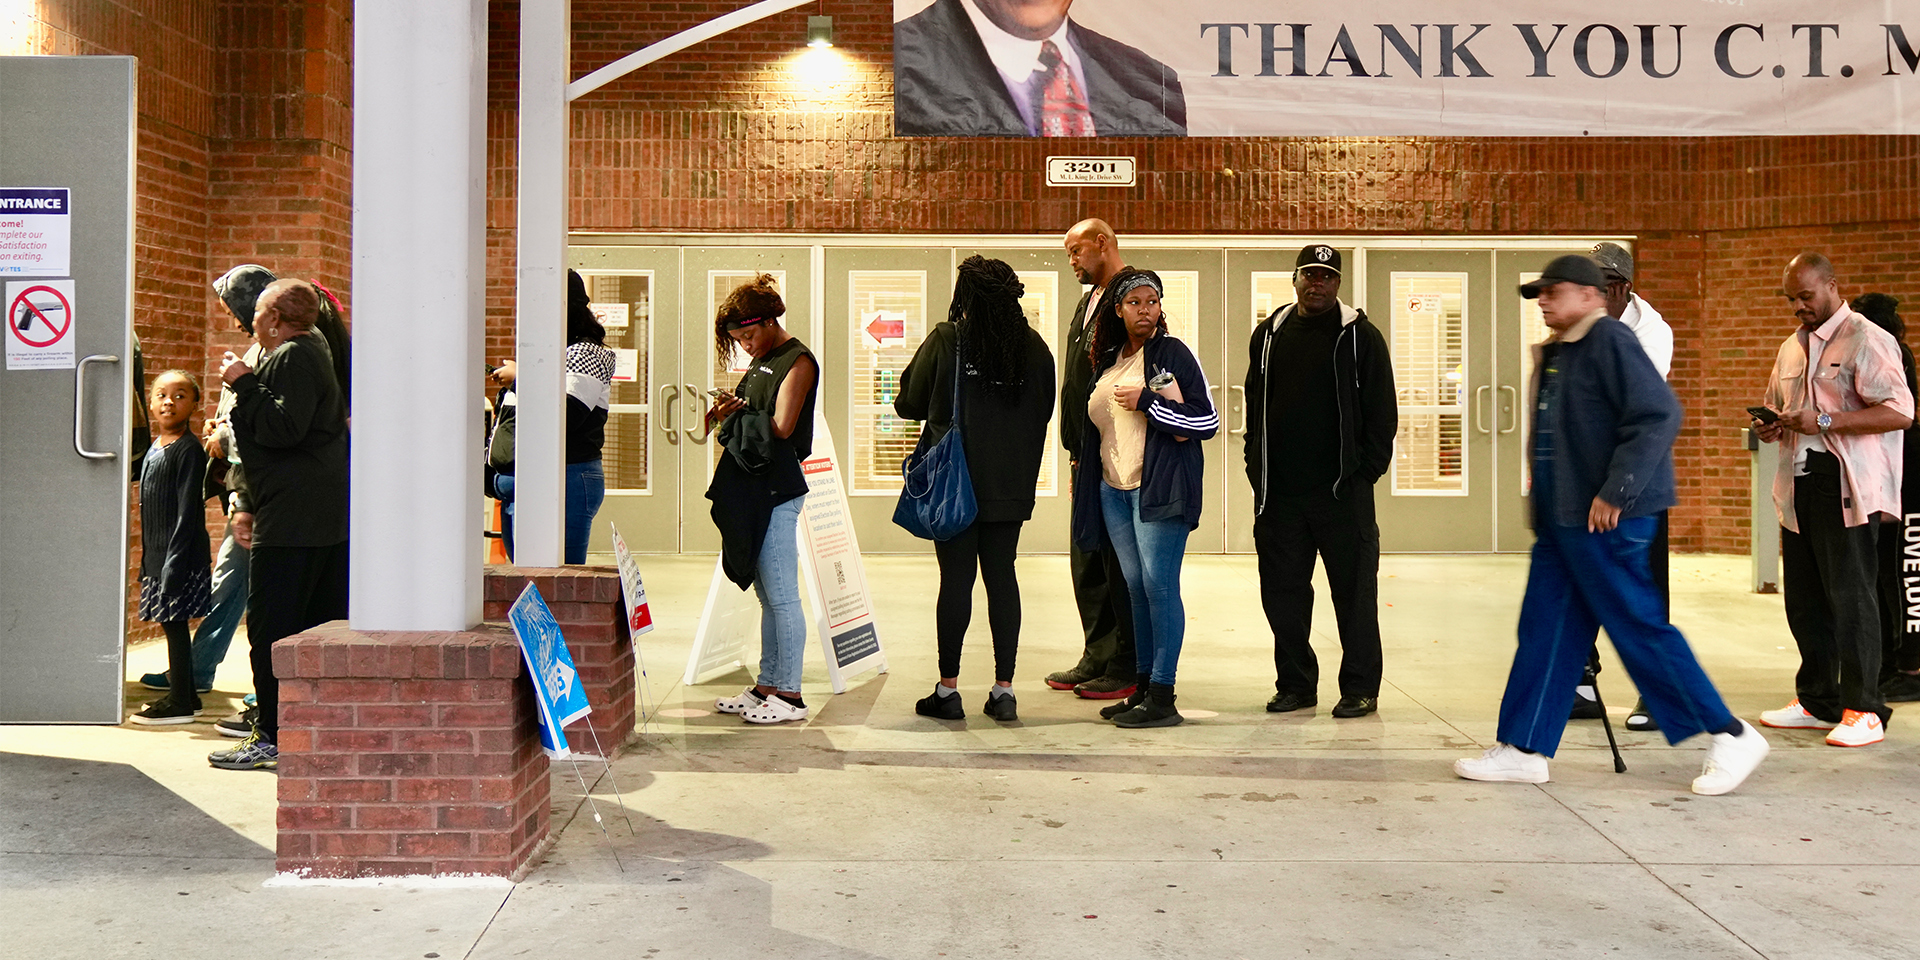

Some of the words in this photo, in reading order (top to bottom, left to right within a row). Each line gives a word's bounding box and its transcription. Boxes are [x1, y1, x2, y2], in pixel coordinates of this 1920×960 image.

[1200, 22, 1494, 78] THANK
[1512, 22, 1687, 79] YOU
[1713, 22, 1854, 79] C.T.
[1063, 161, 1116, 173] 3201
[28, 231, 43, 239] our
[13, 252, 43, 263] exiting.
[605, 329, 627, 337] Enter
[1903, 513, 1920, 572] LOVE
[1903, 576, 1920, 633] LOVE
